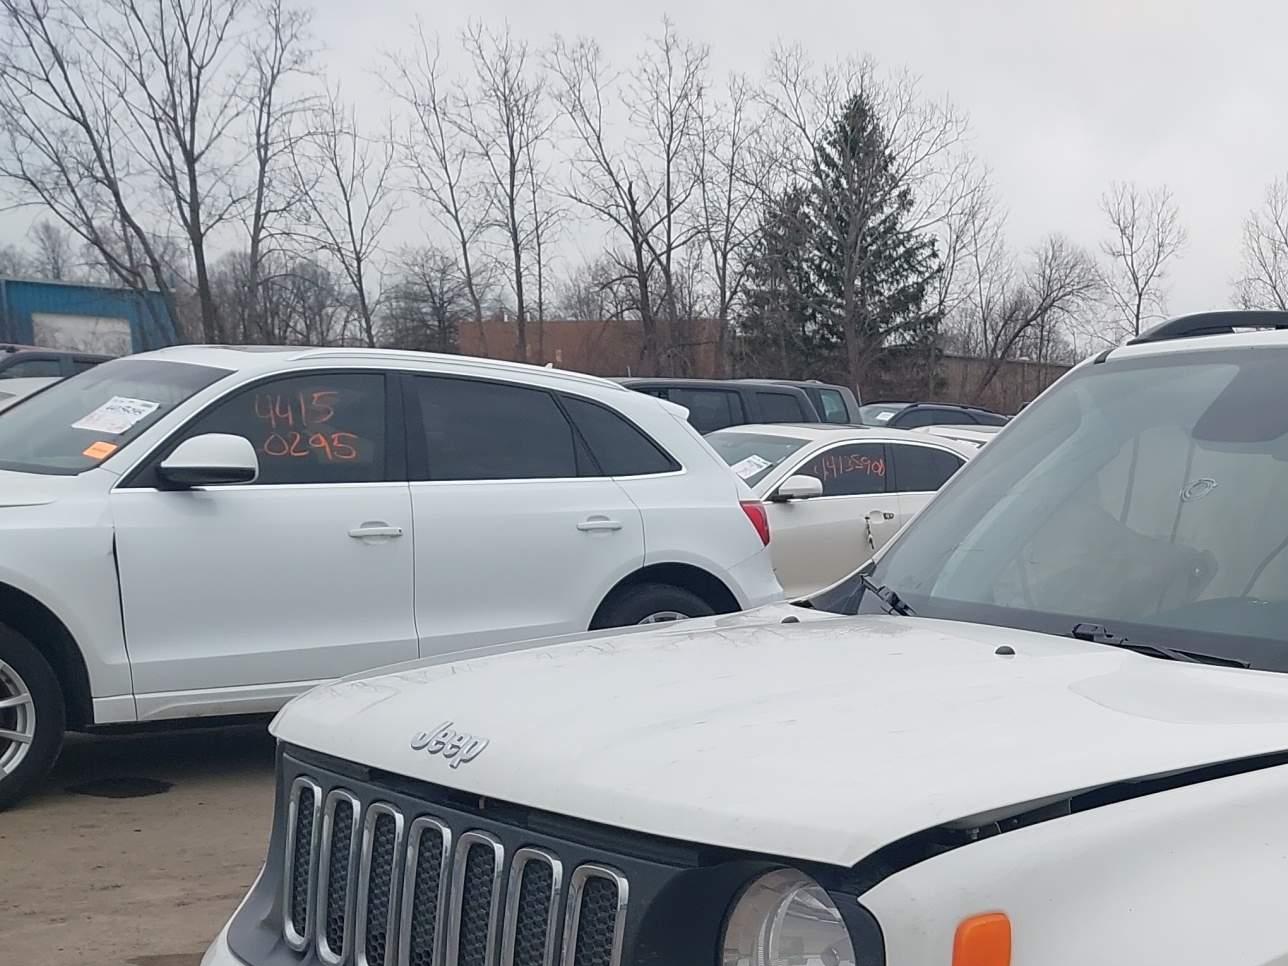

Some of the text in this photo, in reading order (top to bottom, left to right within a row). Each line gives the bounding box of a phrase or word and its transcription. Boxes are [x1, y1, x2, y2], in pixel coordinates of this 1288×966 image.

[255, 391, 339, 428] 4415
[264, 431, 359, 460] 0295
[410, 720, 490, 769] Jeep
